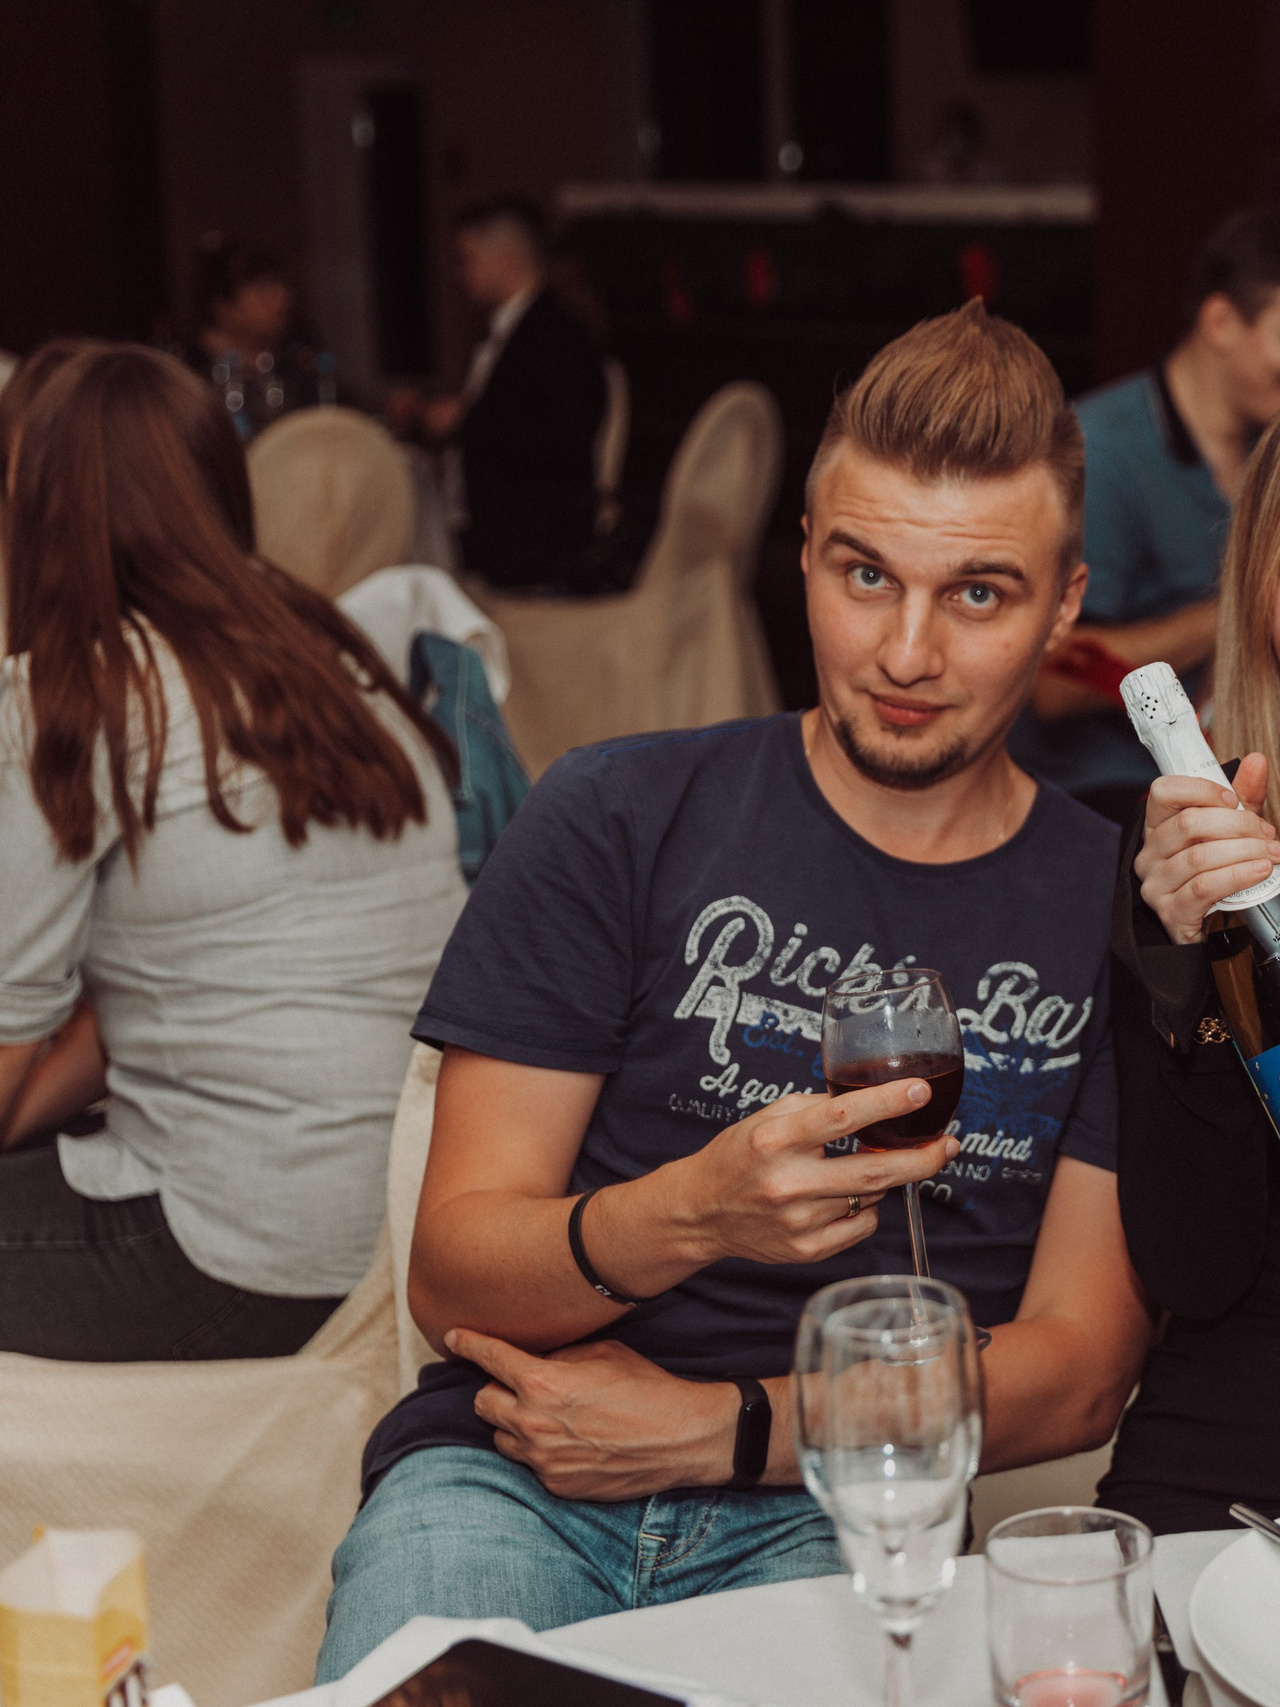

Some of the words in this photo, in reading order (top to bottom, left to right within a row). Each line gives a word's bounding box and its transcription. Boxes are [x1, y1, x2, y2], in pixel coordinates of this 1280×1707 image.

[1245, 883, 1269, 896] BOSCA
[700, 1062, 739, 1099] A
[959, 1129, 1034, 1162] mind
